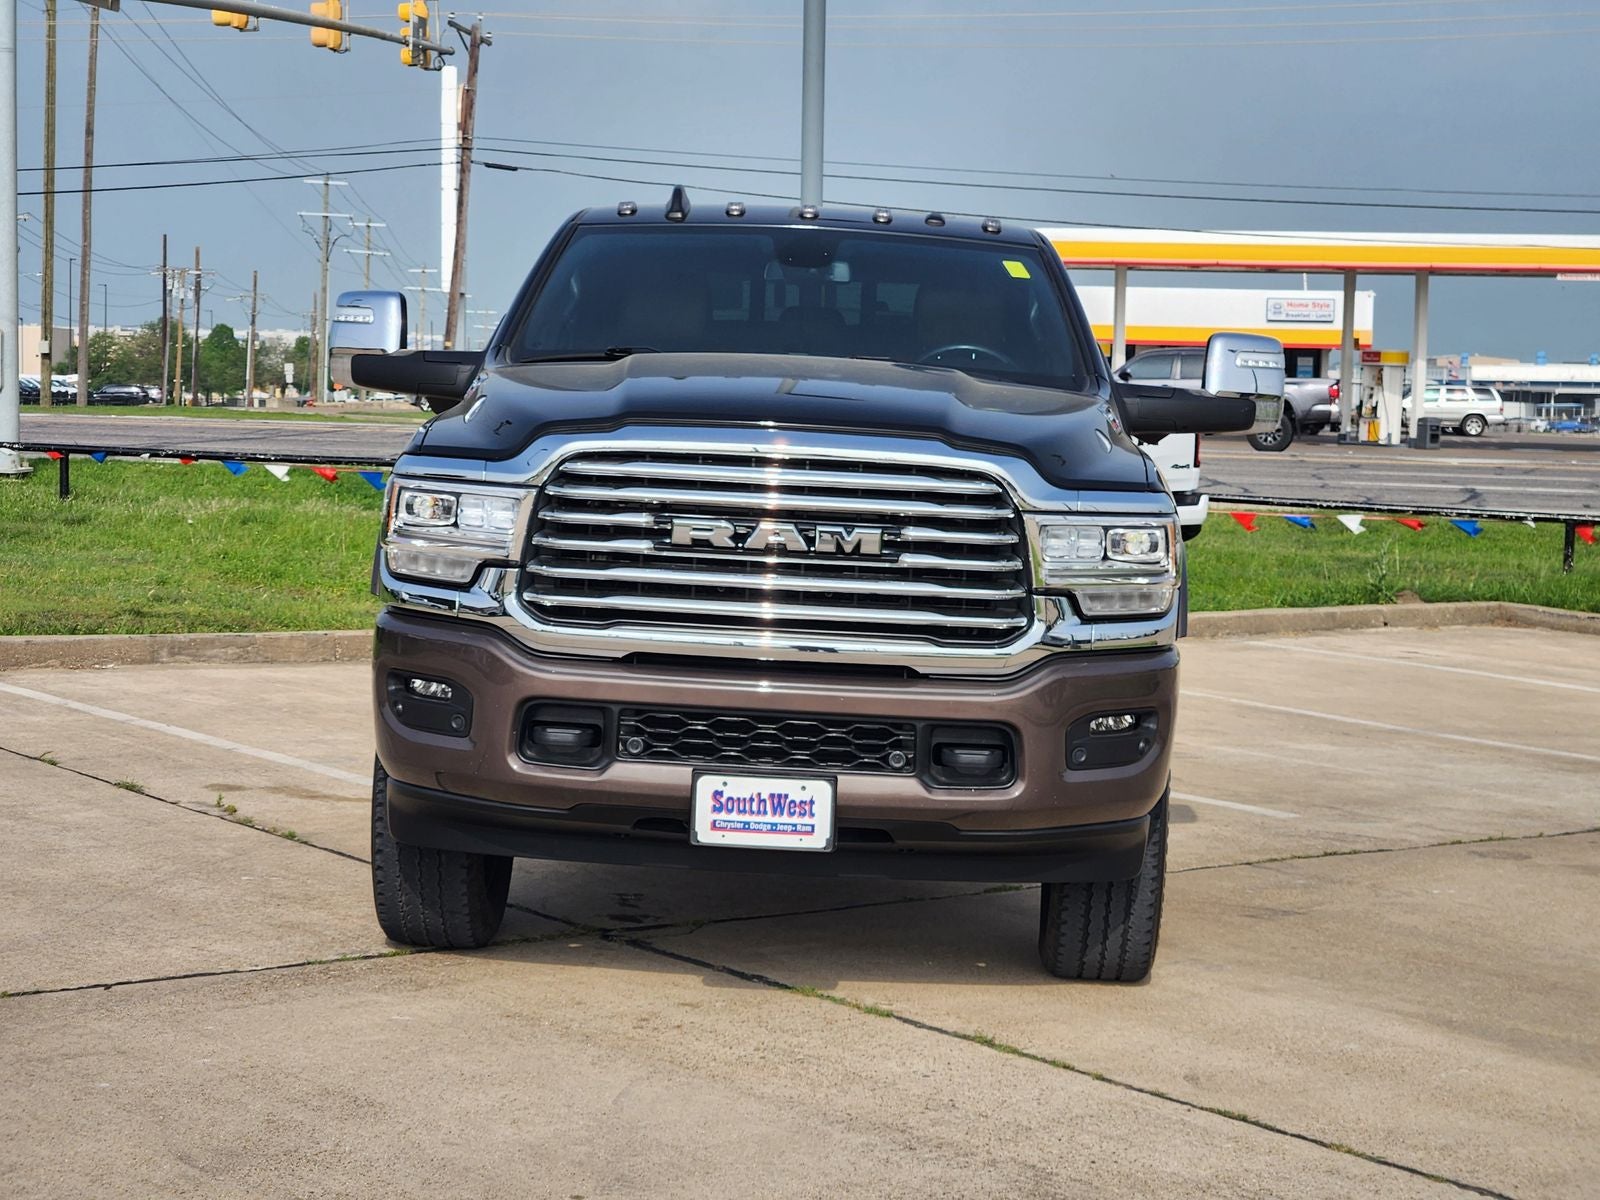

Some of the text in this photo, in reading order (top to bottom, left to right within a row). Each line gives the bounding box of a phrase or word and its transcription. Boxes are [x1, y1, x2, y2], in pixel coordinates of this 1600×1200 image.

[1312, 302, 1330, 310] Style
[671, 518, 883, 555] RAM
[710, 789, 816, 819] SouthWest
[715, 820, 812, 832] Chrysler Dodge Jeep Ram
